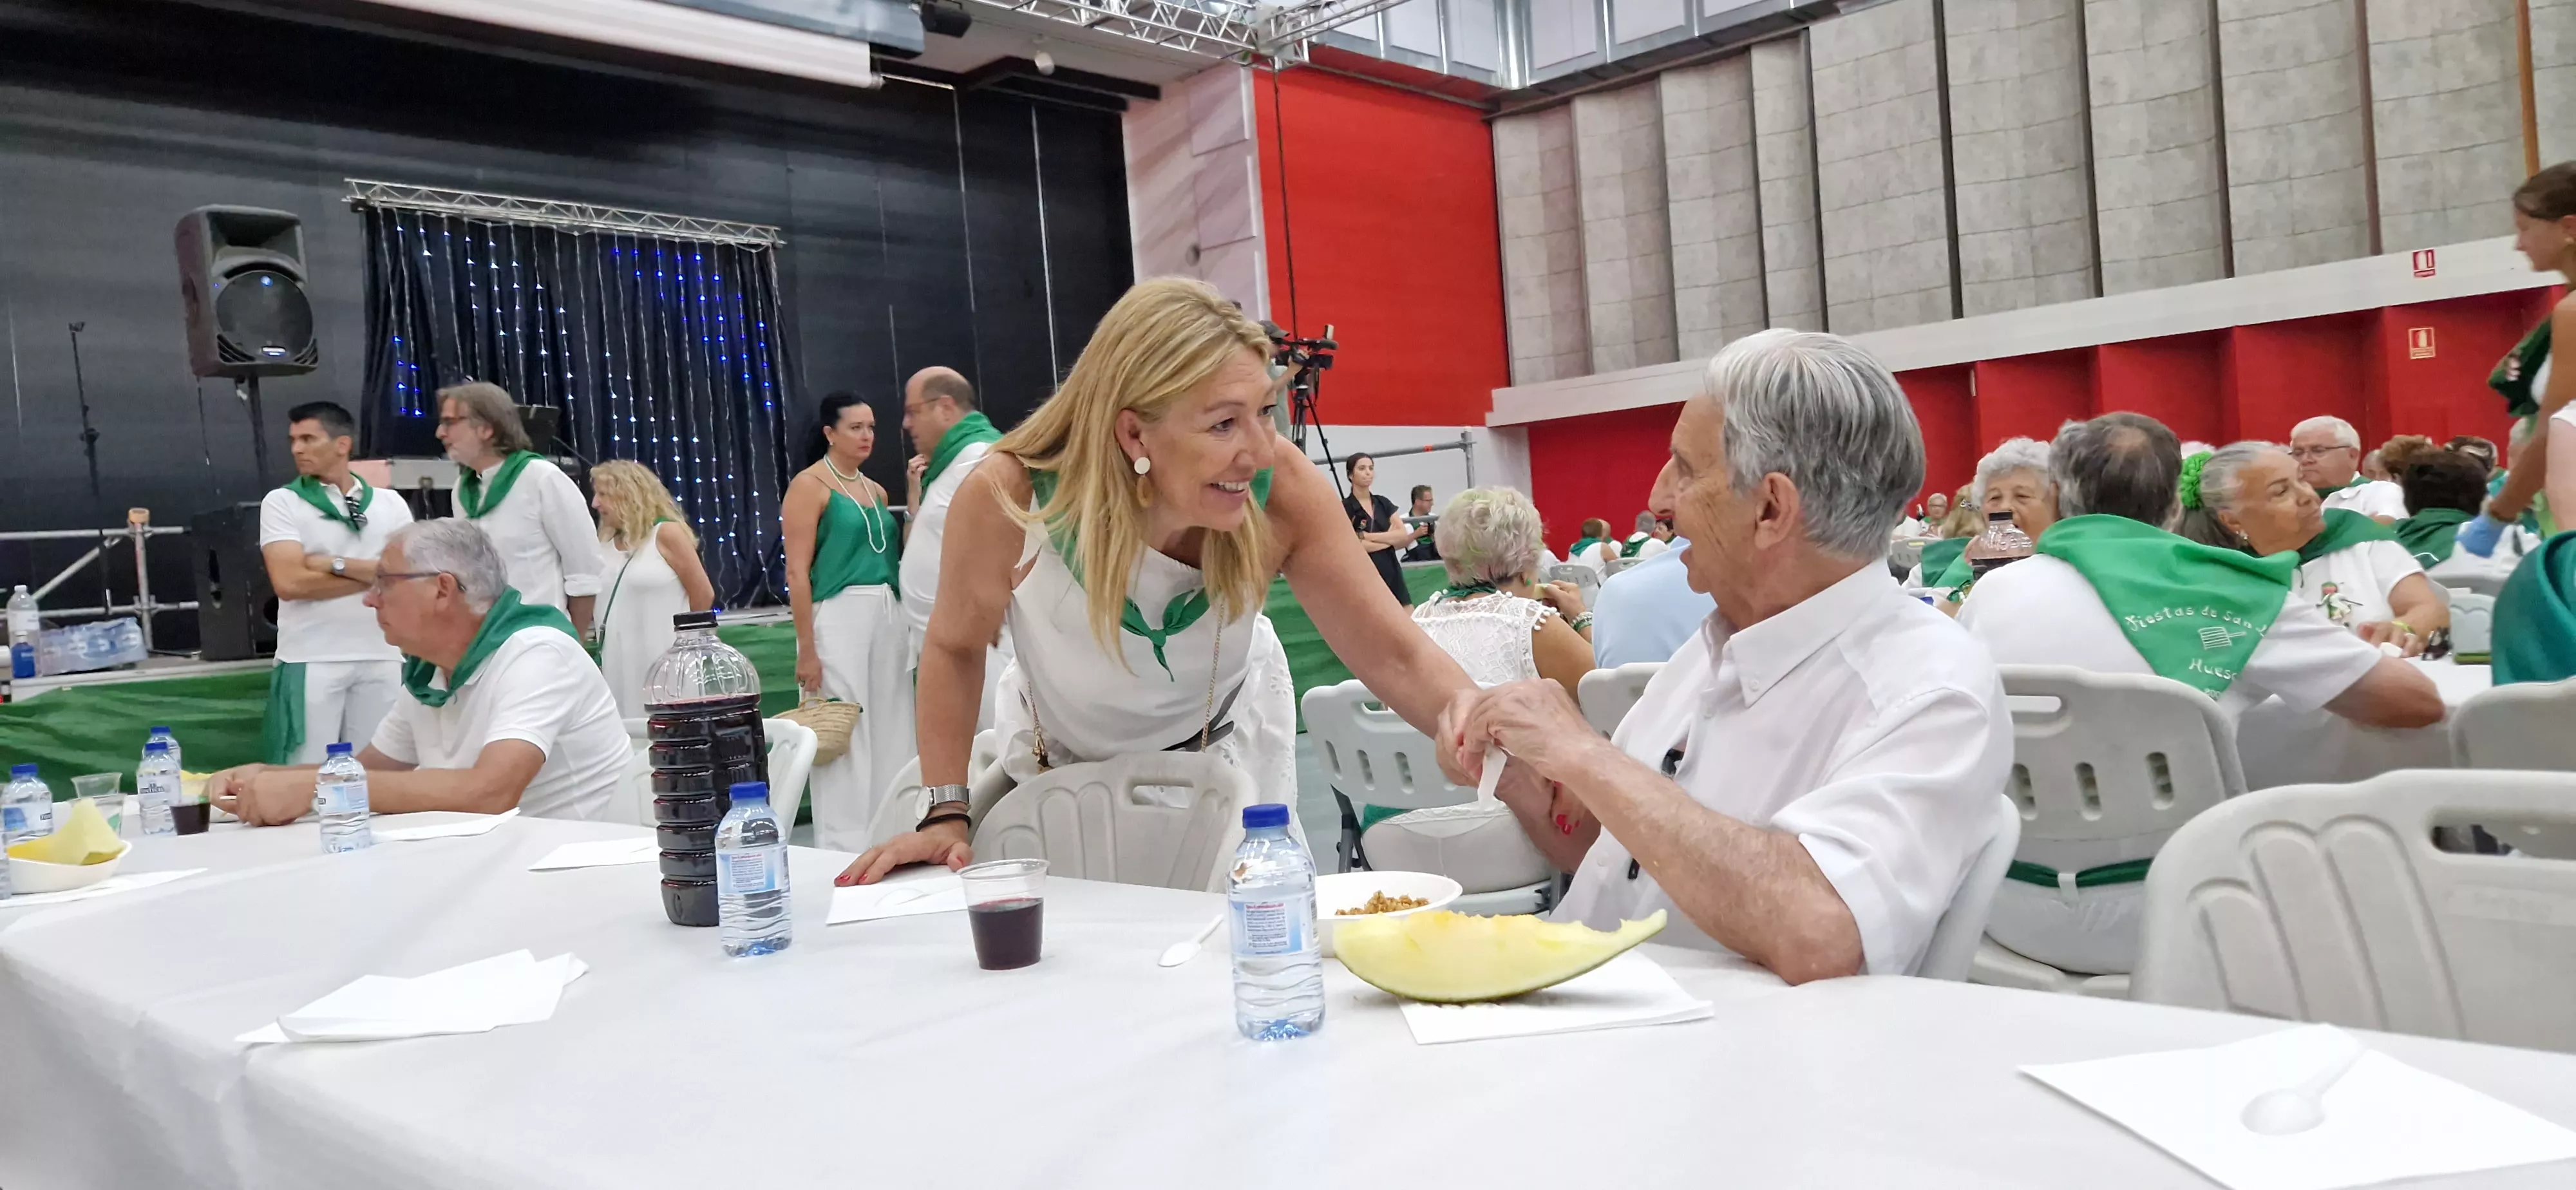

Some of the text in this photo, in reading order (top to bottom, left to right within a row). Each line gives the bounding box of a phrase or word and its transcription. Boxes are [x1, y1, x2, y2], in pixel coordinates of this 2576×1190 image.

[2125, 607, 2193, 631] Fiestas
[2201, 606, 2217, 618] de
[2223, 610, 2252, 629] San
